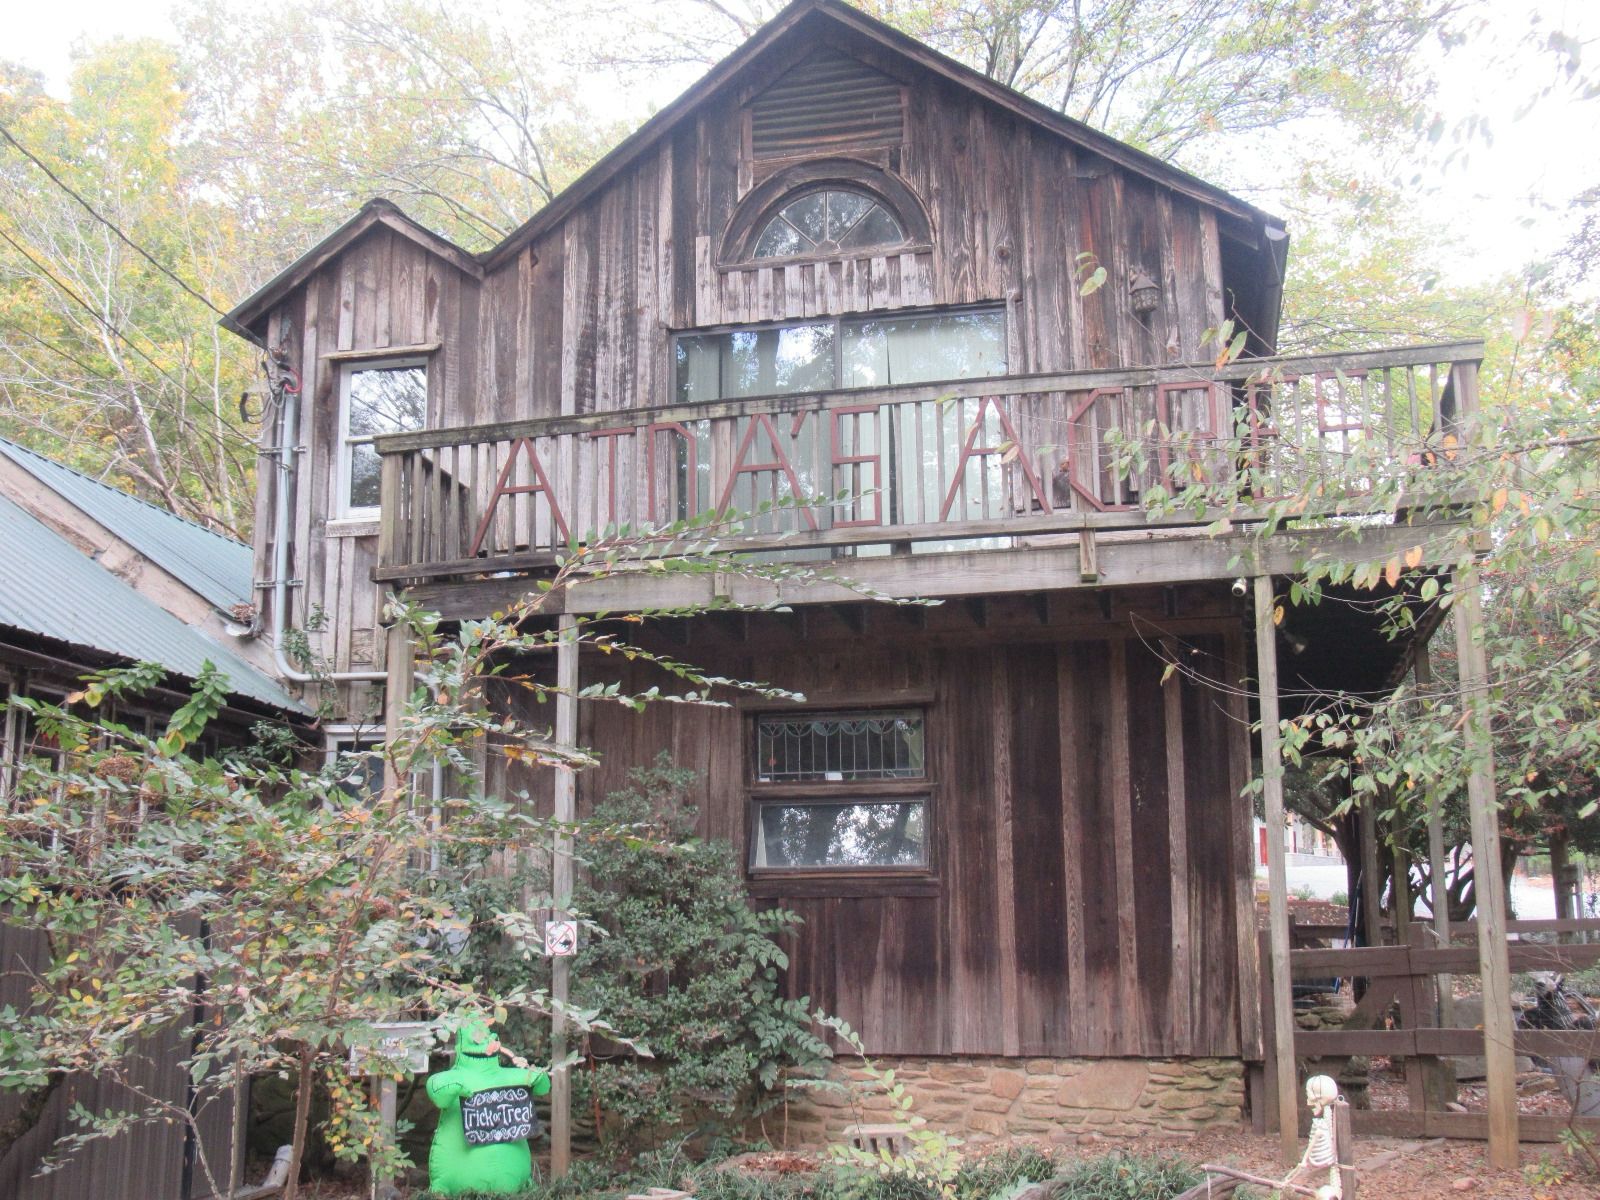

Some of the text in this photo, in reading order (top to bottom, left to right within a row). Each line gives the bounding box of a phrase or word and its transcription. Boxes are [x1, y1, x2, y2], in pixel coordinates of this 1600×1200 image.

[938, 367, 1374, 523] ACRES
[462, 1100, 533, 1130] Trick or Treat
